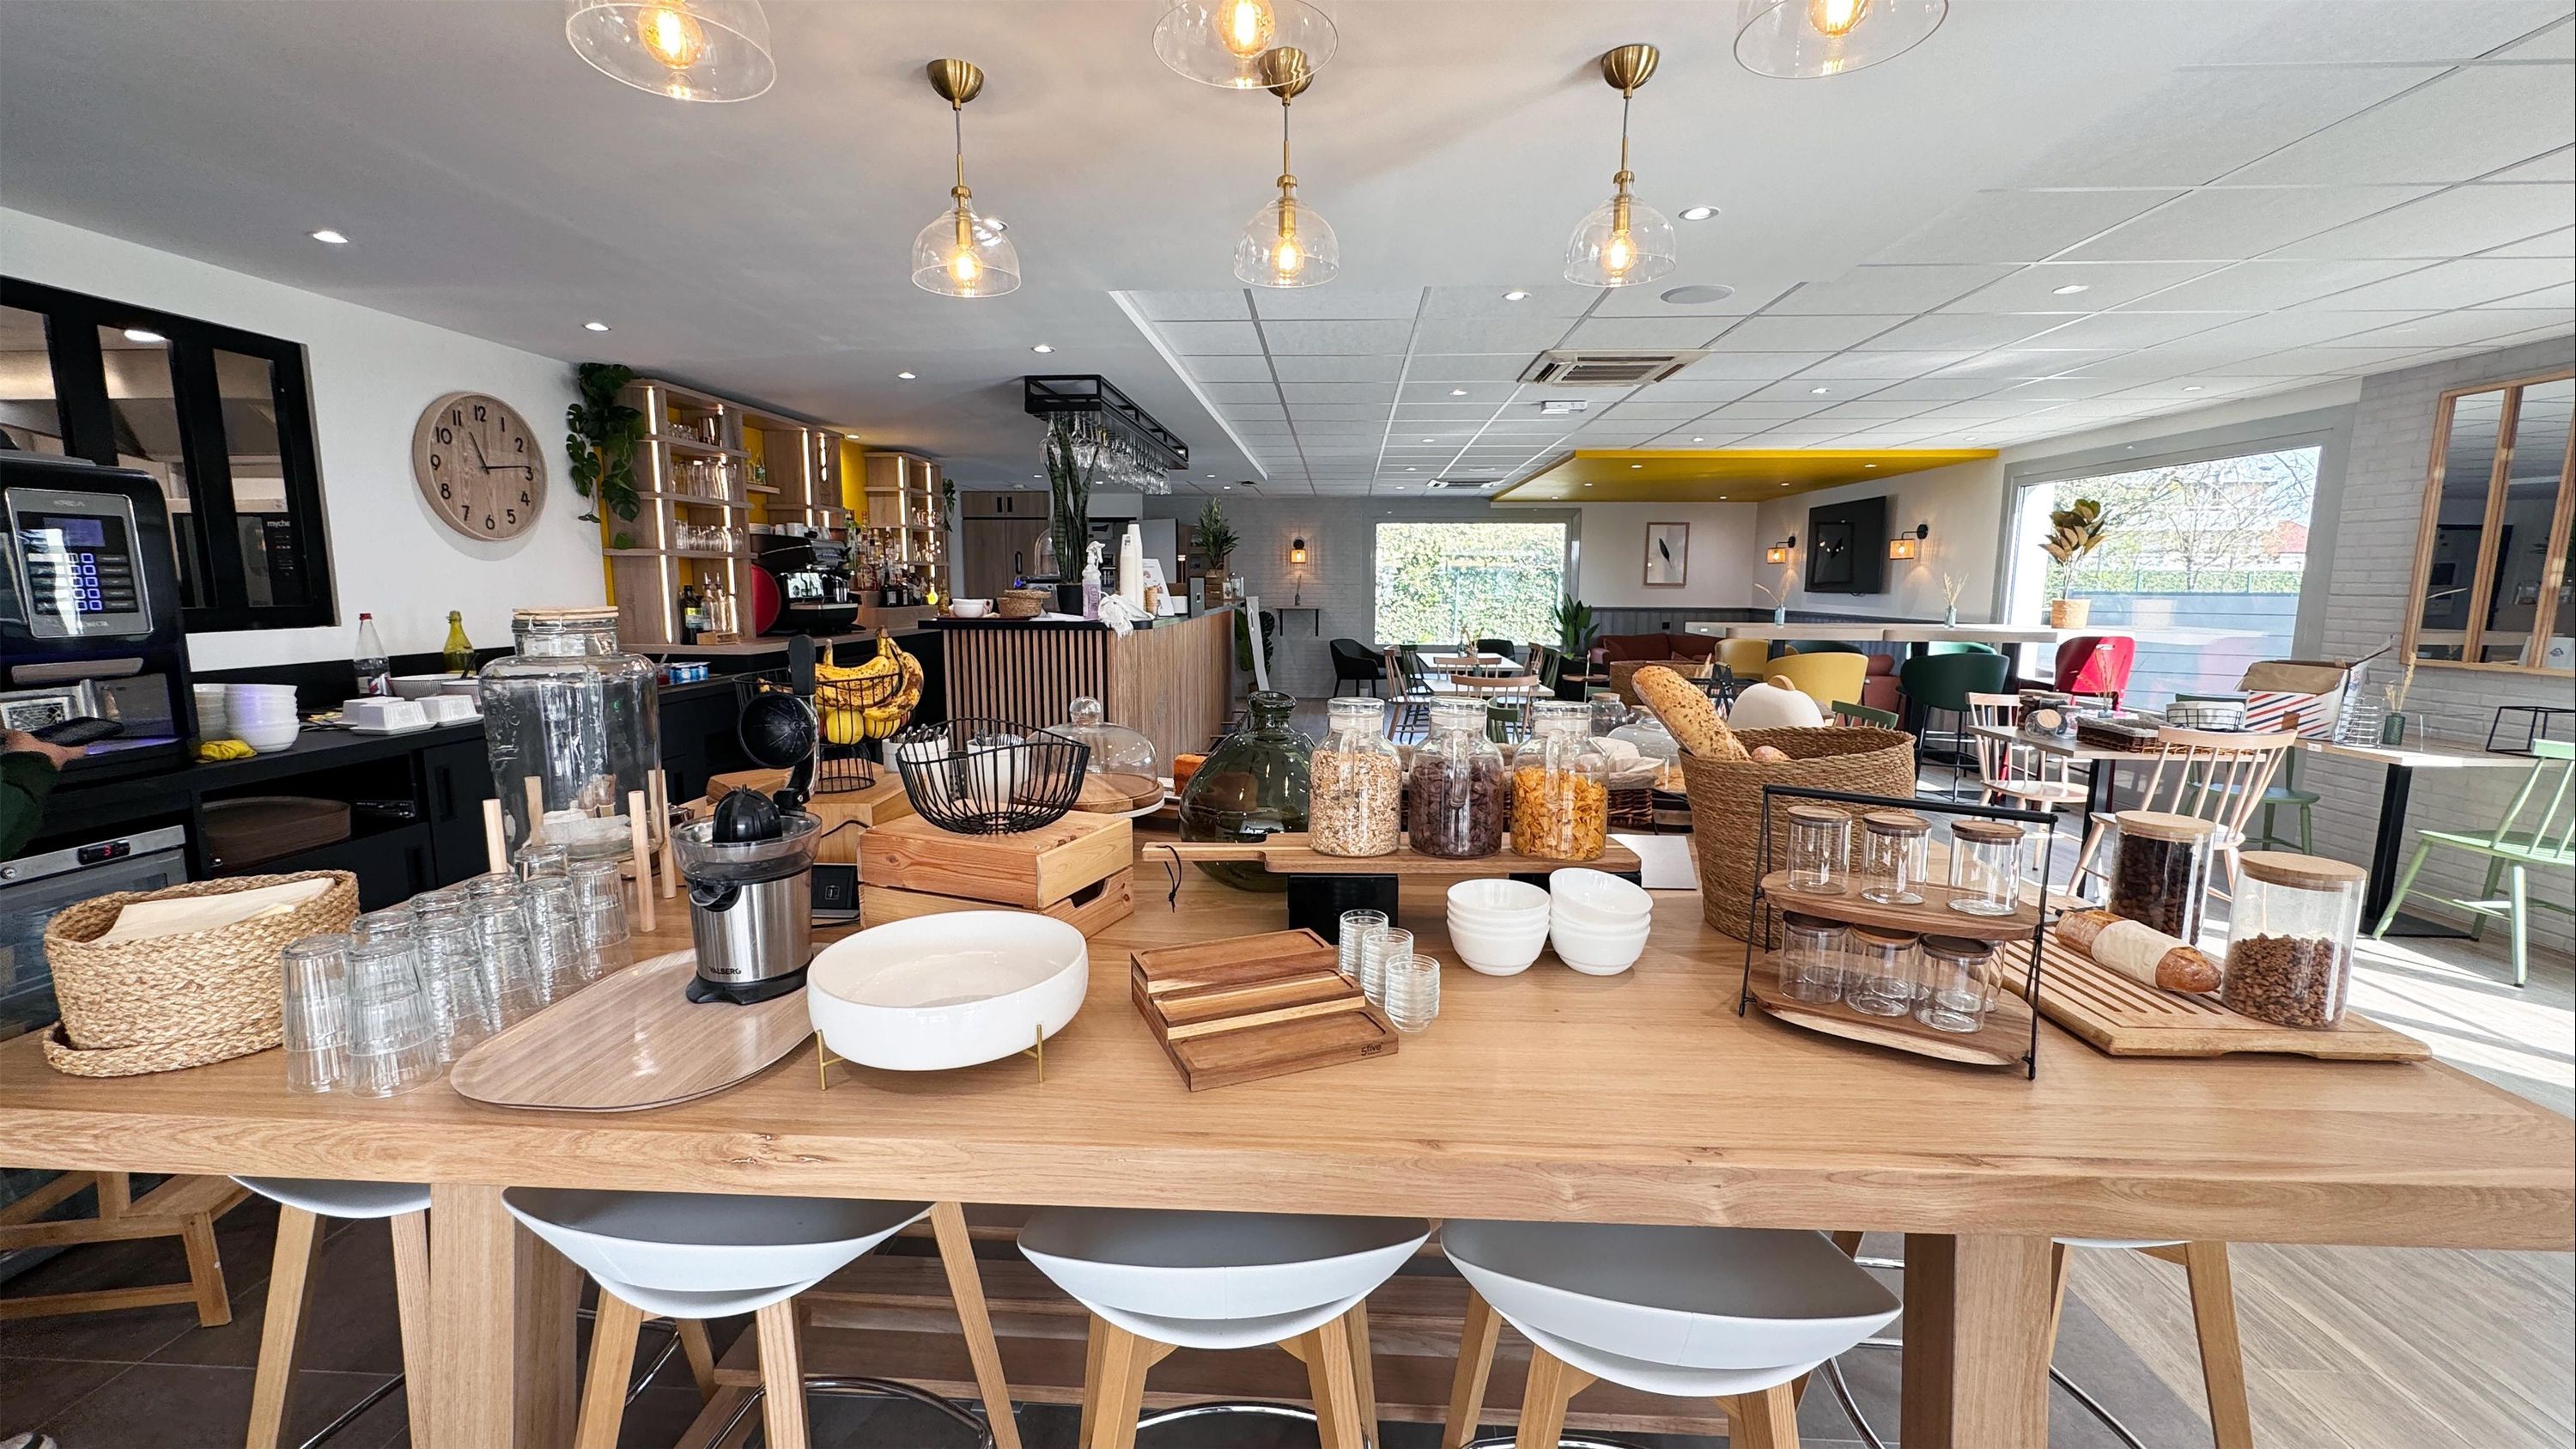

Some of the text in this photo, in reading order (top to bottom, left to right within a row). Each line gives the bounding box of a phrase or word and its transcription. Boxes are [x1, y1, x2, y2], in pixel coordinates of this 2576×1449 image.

[453, 410, 462, 427] 11
[474, 405, 486, 422] 12
[501, 417, 506, 432] 1
[435, 427, 453, 445] 10
[515, 437, 524, 454] 2
[431, 454, 440, 470] 9
[525, 466, 534, 482] 3
[440, 484, 451, 499] 8
[520, 491, 531, 507] 4
[461, 505, 470, 521] 7
[507, 509, 516, 525] 5
[485, 514, 495, 531] 6
